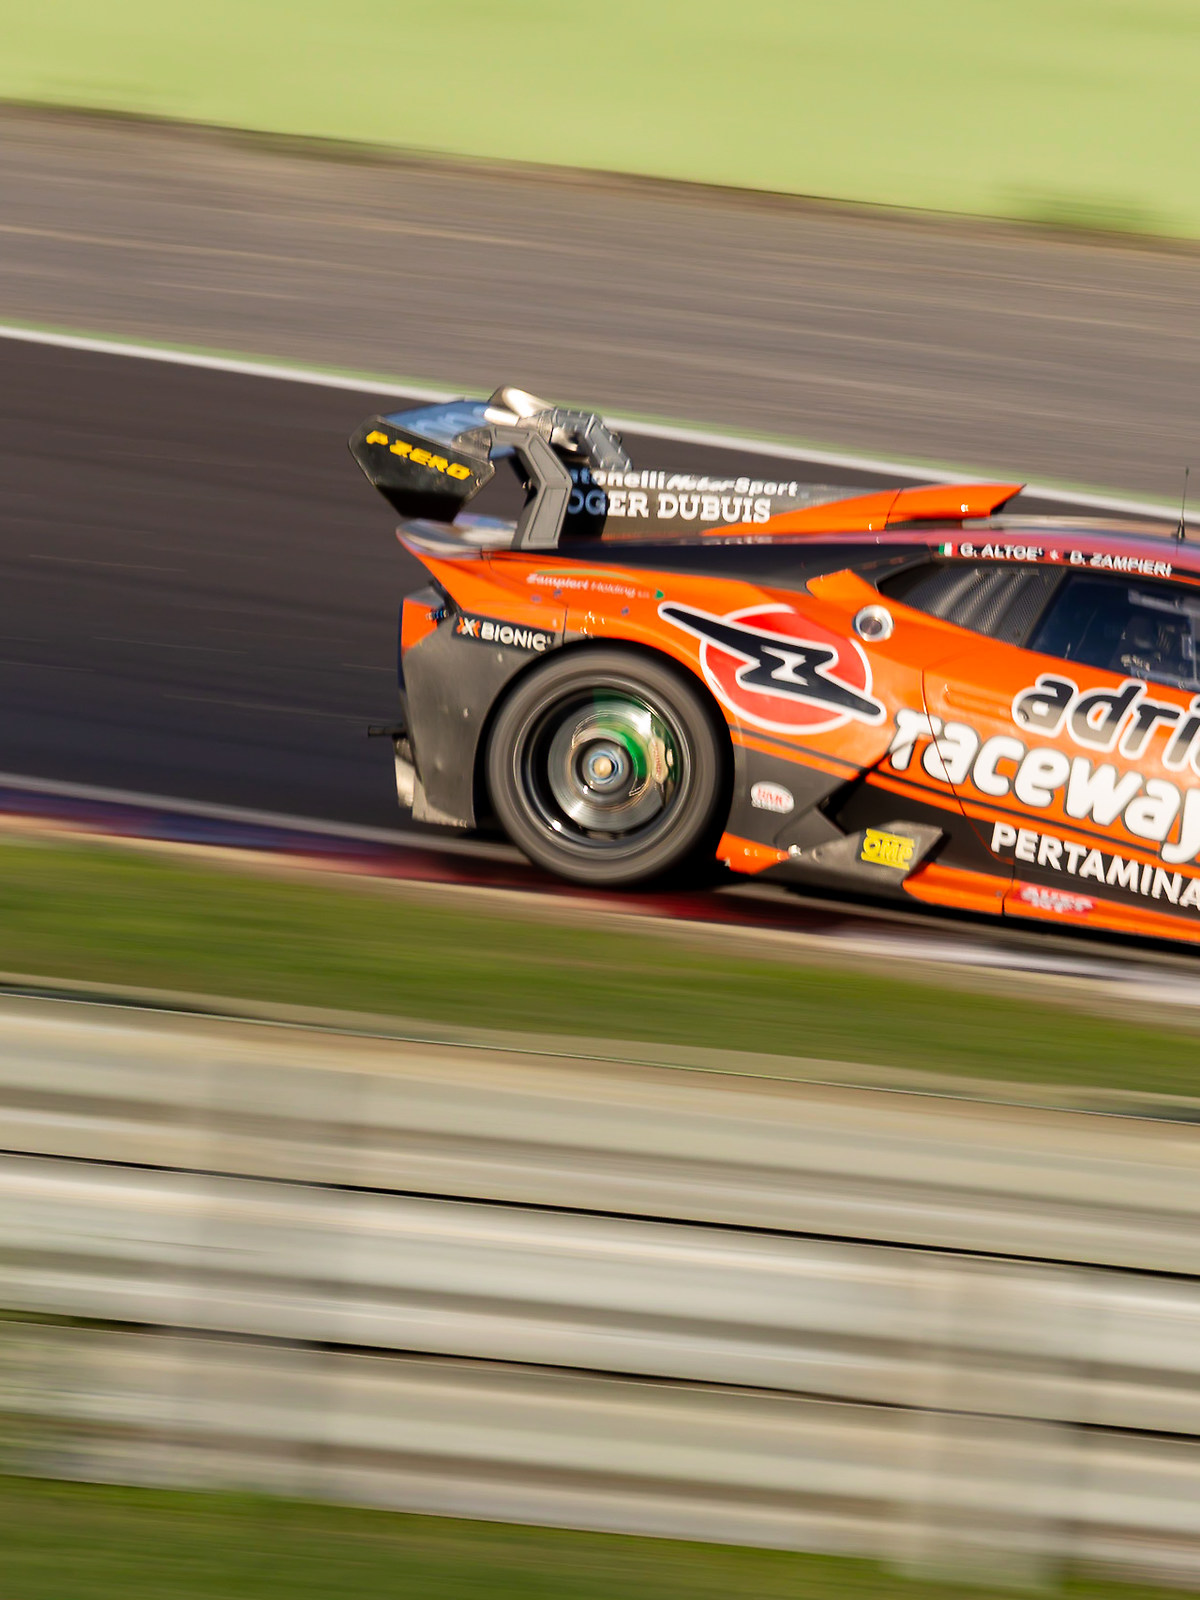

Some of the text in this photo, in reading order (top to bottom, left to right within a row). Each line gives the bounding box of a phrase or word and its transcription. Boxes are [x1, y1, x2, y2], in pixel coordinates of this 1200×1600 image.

[366, 430, 473, 480] P ZERO
[570, 467, 665, 490] tonelli
[567, 488, 771, 524] OGER DUBUIS
[1090, 552, 1172, 578] ZAMPIERI
[481, 622, 547, 652] BIONIC
[862, 832, 913, 868] OMP
